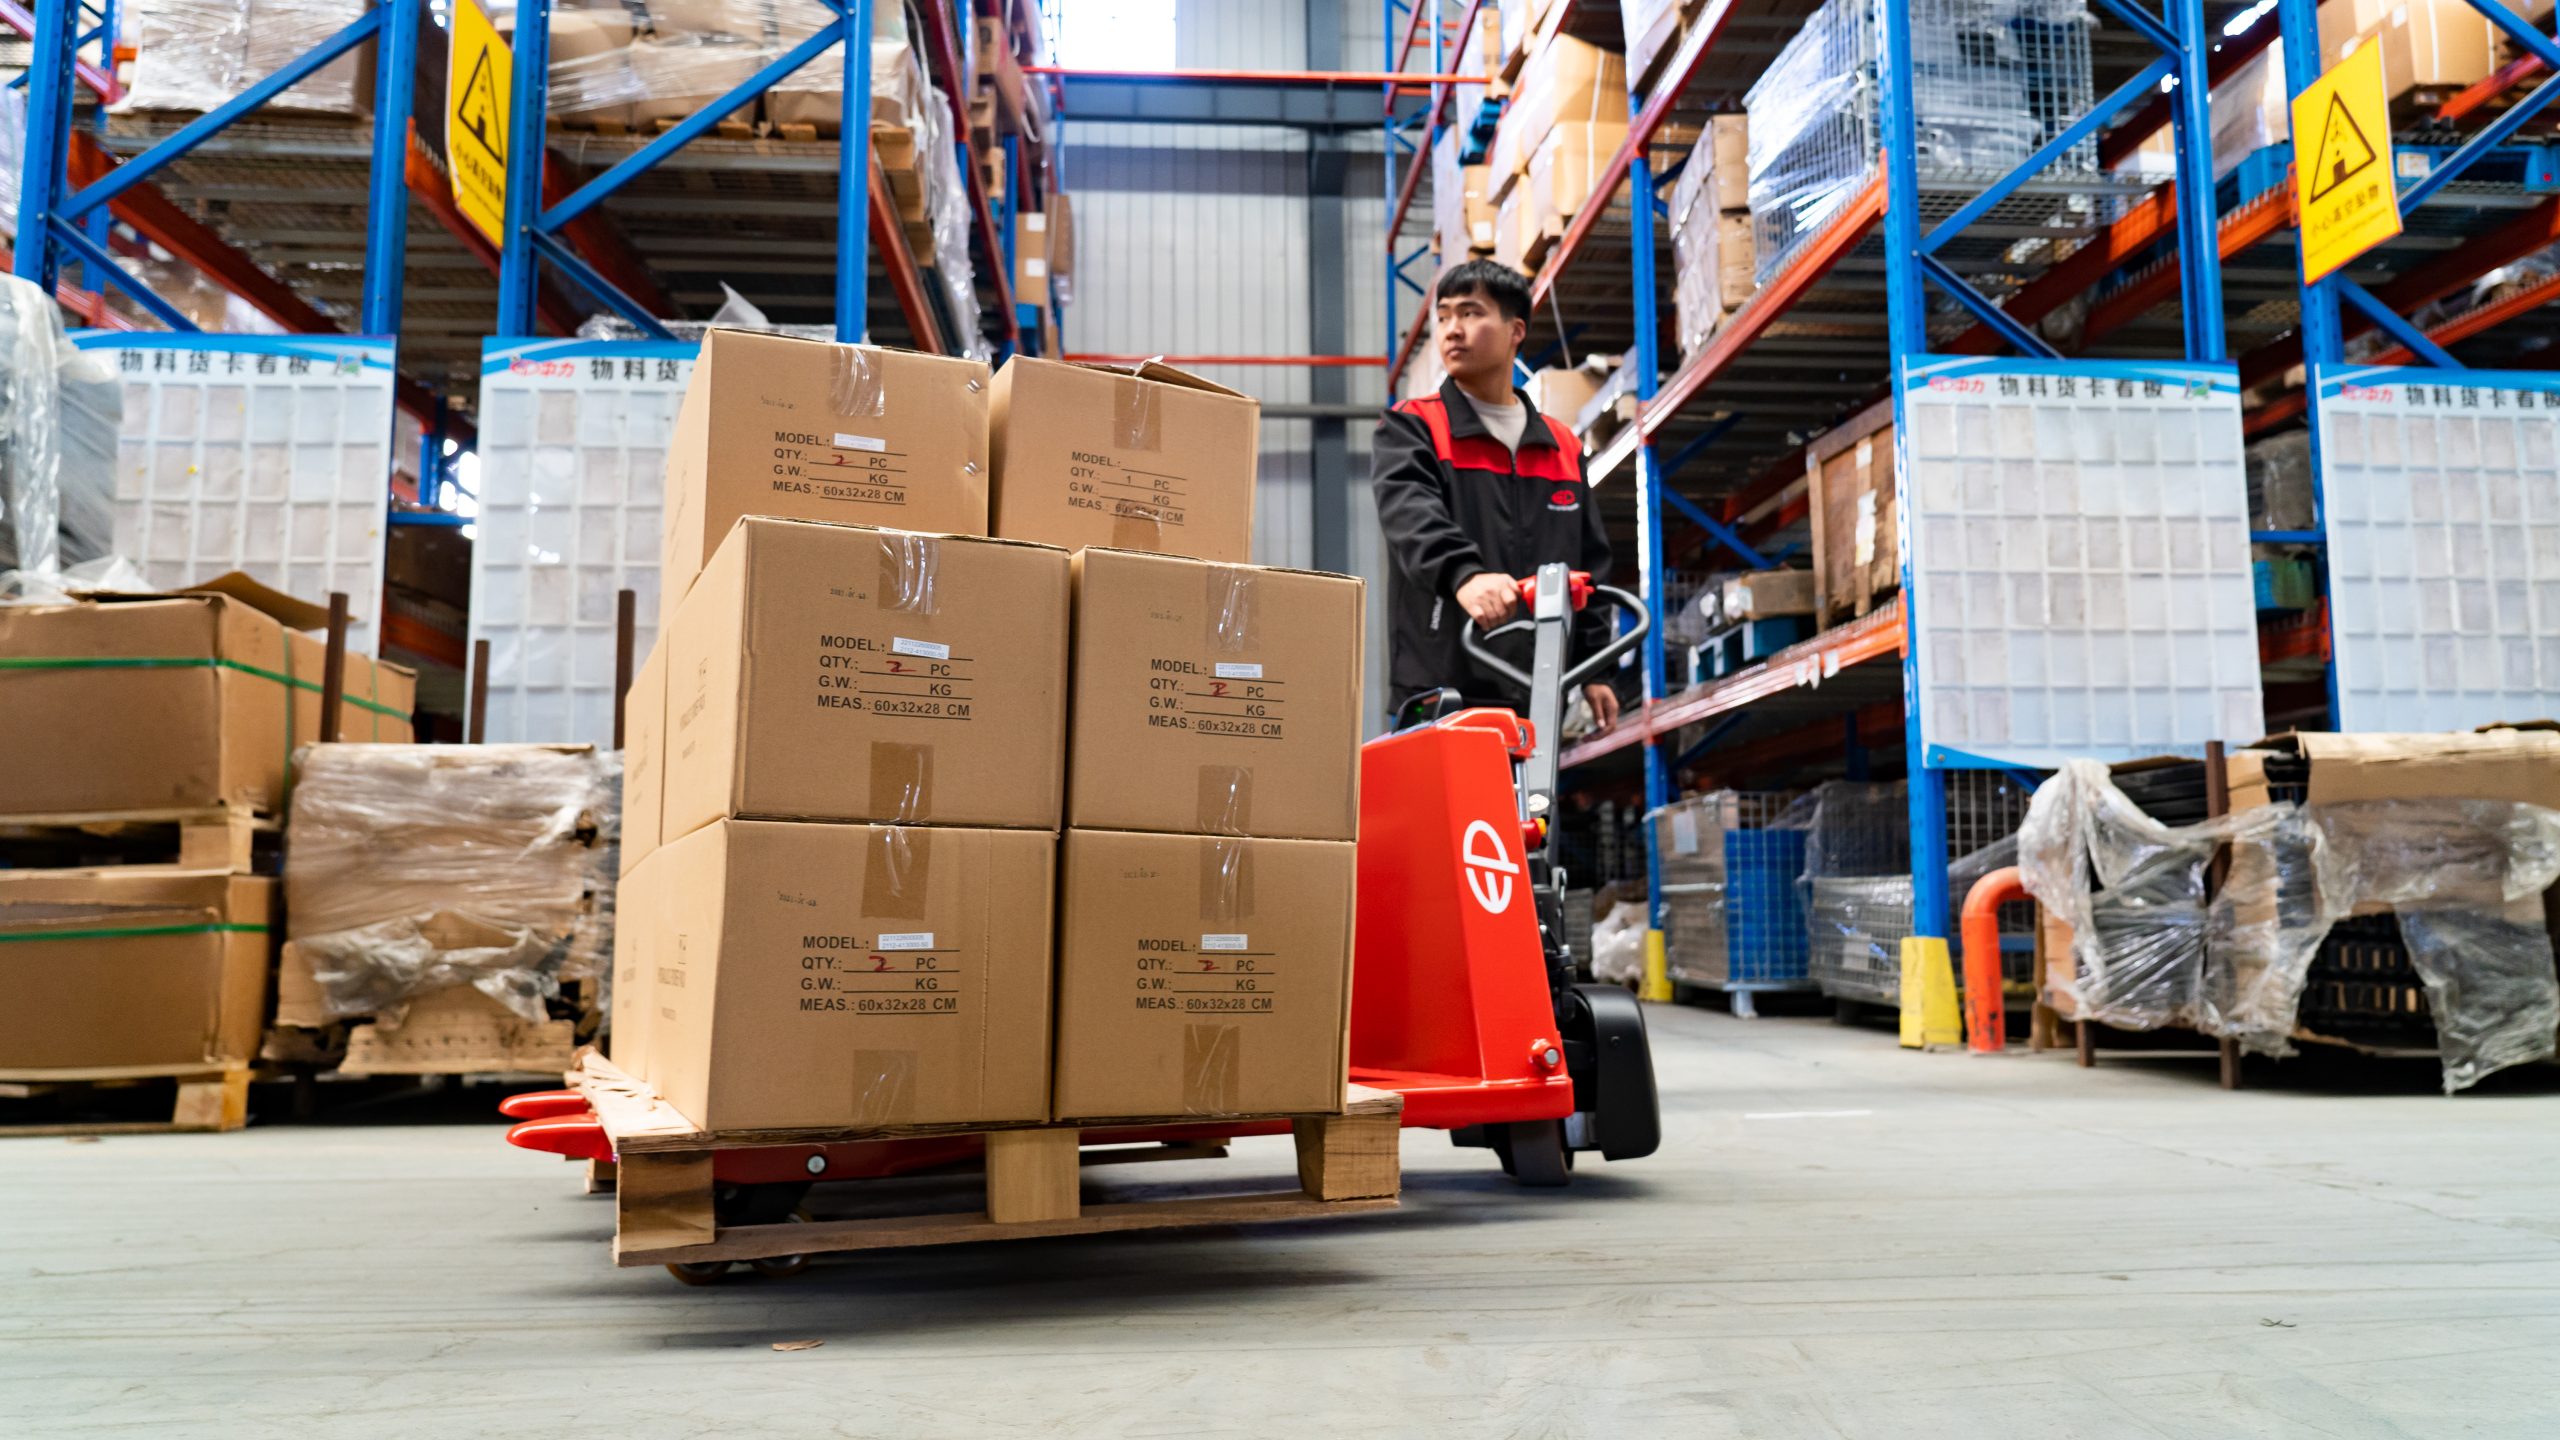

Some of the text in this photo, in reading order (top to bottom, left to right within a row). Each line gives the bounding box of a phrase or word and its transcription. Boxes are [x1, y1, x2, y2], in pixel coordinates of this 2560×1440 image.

[120, 350, 311, 375] 物料货卡看板
[1999, 376, 2164, 398] 物料货卡看板
[775, 431, 830, 447] MODEL.:
[774, 448, 887, 468] QTY.: PC
[1071, 451, 1121, 467] MODEL.:
[869, 474, 888, 484] KG
[1070, 467, 1170, 490] QTY.: 1 PC
[823, 486, 881, 499] 60x32x28
[884, 491, 904, 502] CM
[1152, 495, 1170, 505] KG
[1166, 511, 1183, 522] CM
[820, 635, 885, 652] MODEL.:
[819, 655, 950, 676] QTY.: PC
[1151, 658, 1207, 675] MODEL.:
[929, 684, 952, 696] KG
[1150, 678, 1264, 698] QTY.: PC
[874, 700, 940, 714] 60x32x28
[947, 704, 970, 716] CM
[1246, 705, 1265, 716] KG
[1198, 720, 1255, 734] 60x32x28
[1261, 724, 1281, 735] CM
[1463, 819, 1520, 914] EP
[803, 936, 869, 949] MODEL.:
[1138, 939, 1196, 952] MODEL.:
[802, 957, 937, 970] QTY.: PC
[1137, 958, 1255, 971] QTY.: PC
[915, 978, 938, 990] KG
[1235, 979, 1256, 991] KG
[858, 999, 926, 1011] 60x32x28
[933, 997, 957, 1010] CM
[1187, 999, 1246, 1010] 60x32x28
[1251, 998, 1272, 1010] CM
